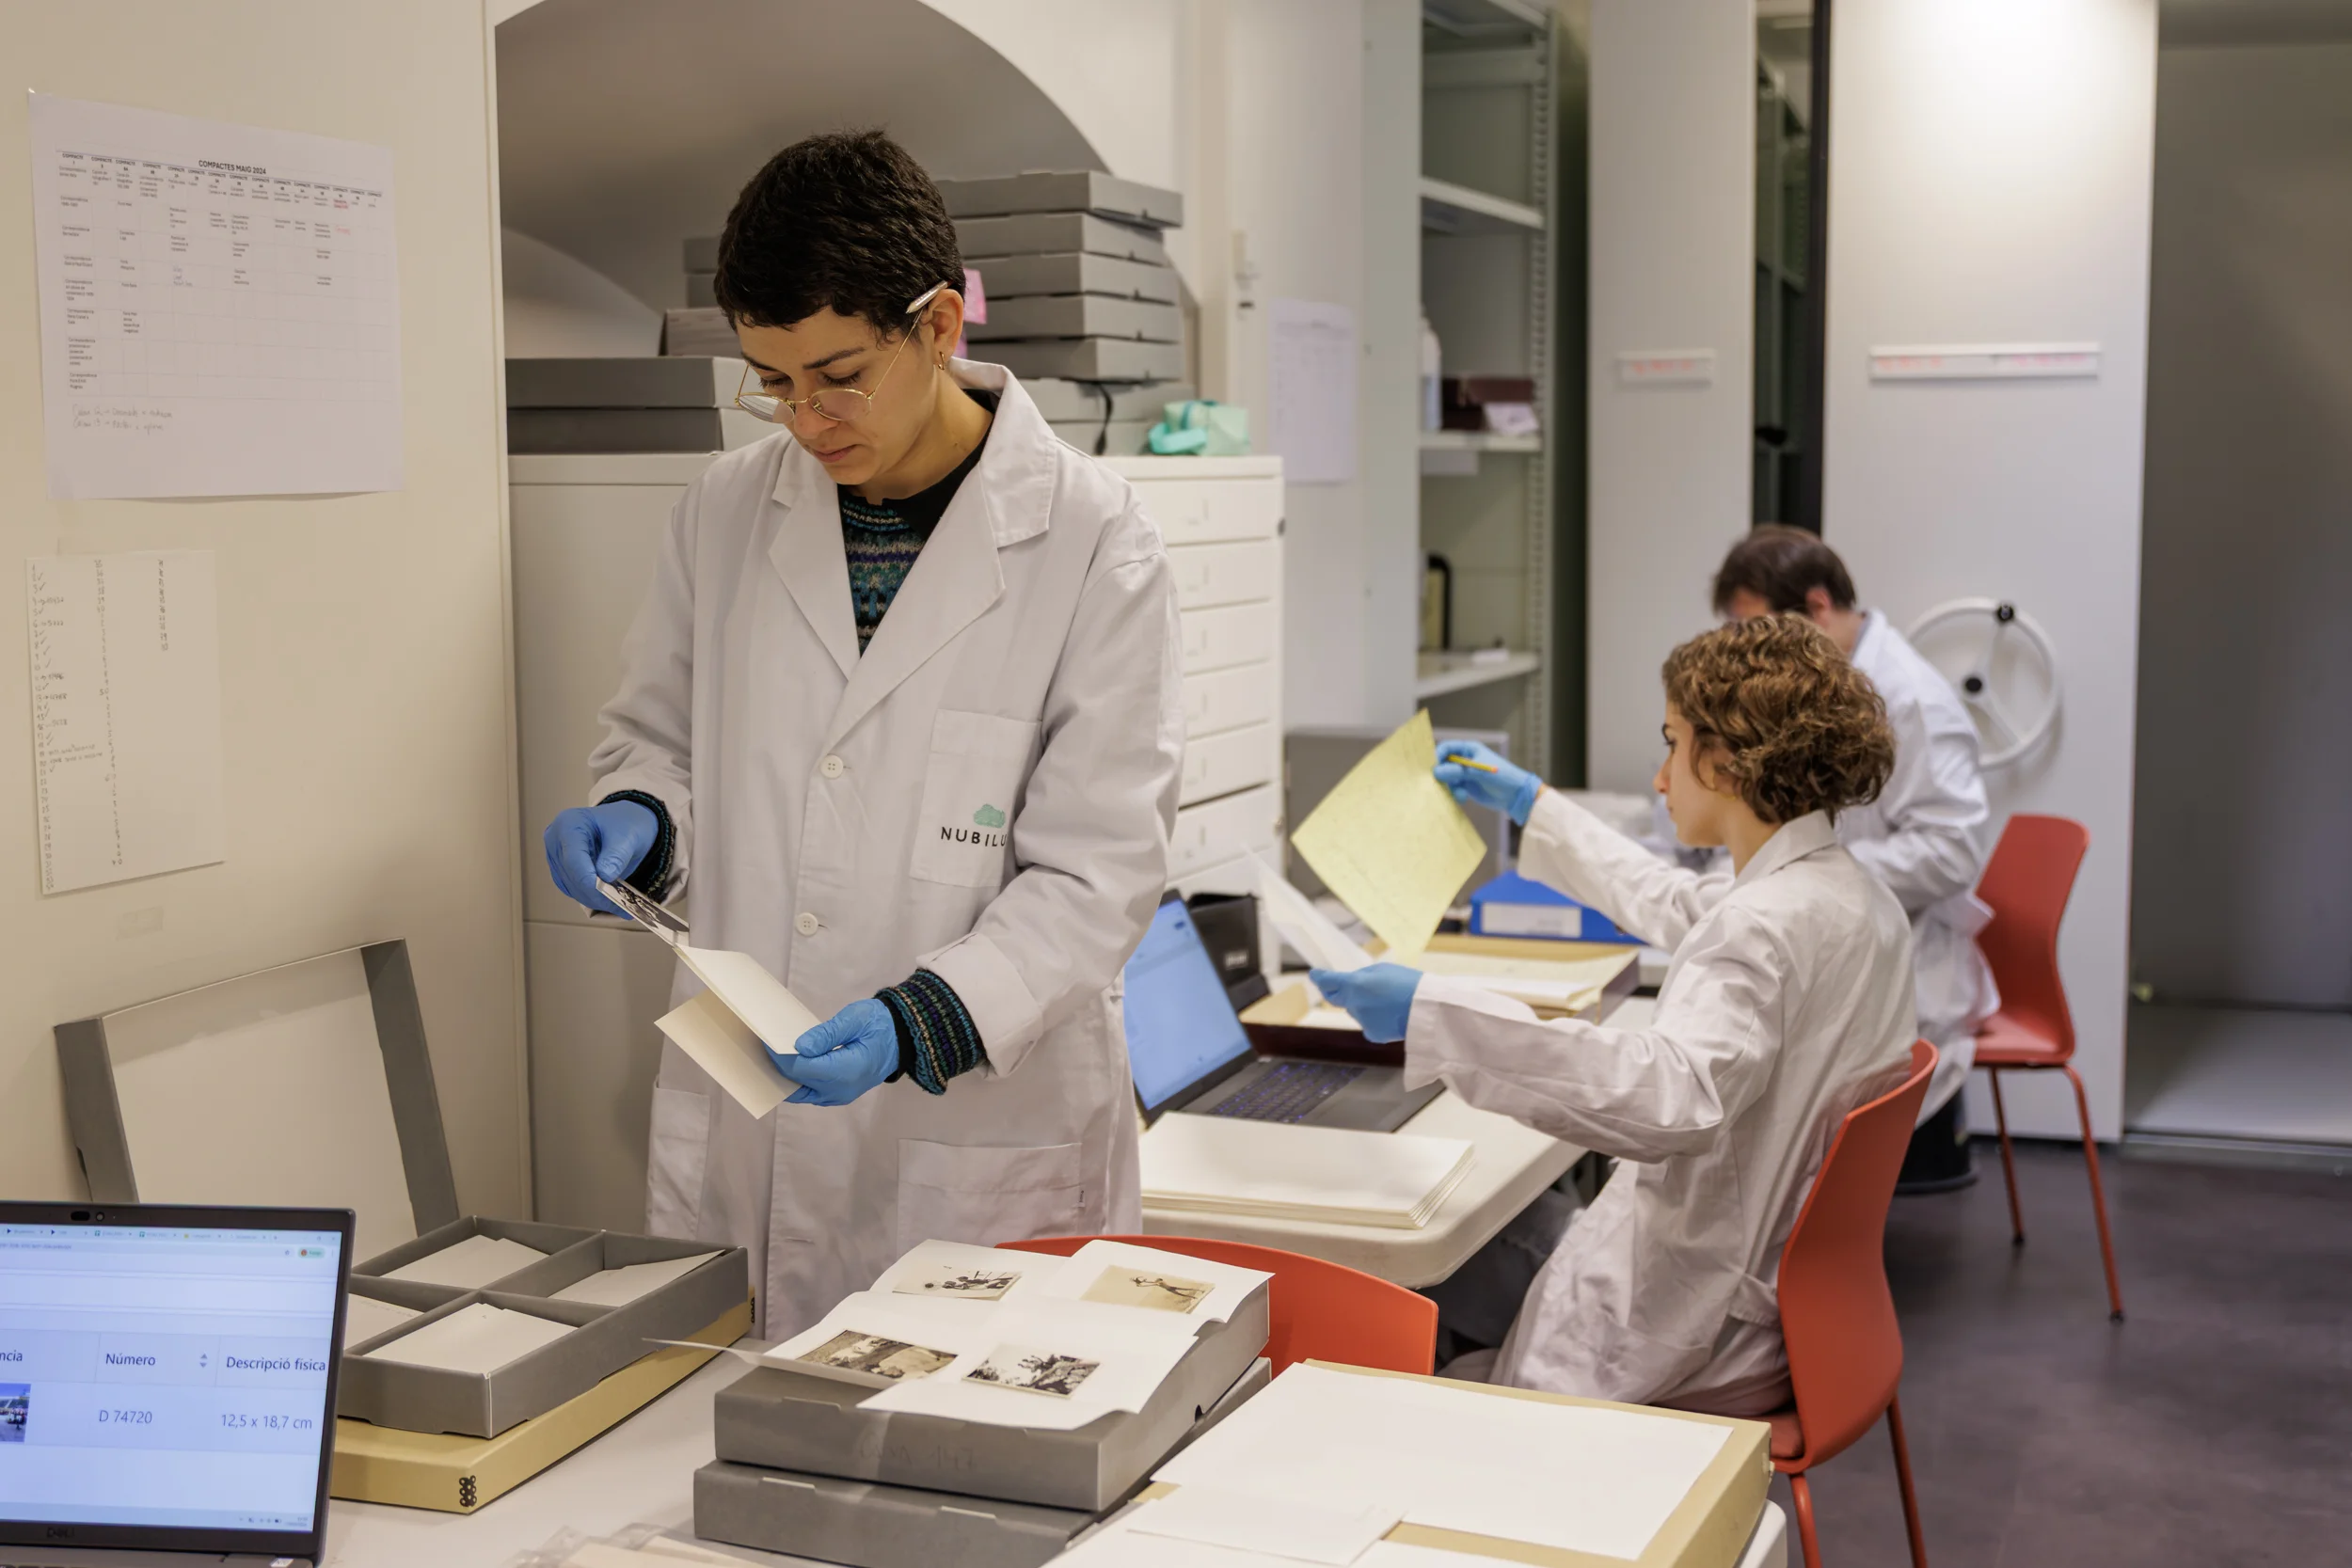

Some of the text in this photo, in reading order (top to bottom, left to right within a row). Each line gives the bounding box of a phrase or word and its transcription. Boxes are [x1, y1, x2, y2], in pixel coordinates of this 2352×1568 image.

[199, 160, 235, 171] COMPACTES
[236, 165, 252, 173] MAIG
[106, 1352, 156, 1366] Número
[226, 1357, 291, 1372] Descripció
[295, 1358, 326, 1371] física
[99, 1410, 152, 1424] D 74720
[221, 1414, 312, 1430] 12,5 x 18,7 cm
